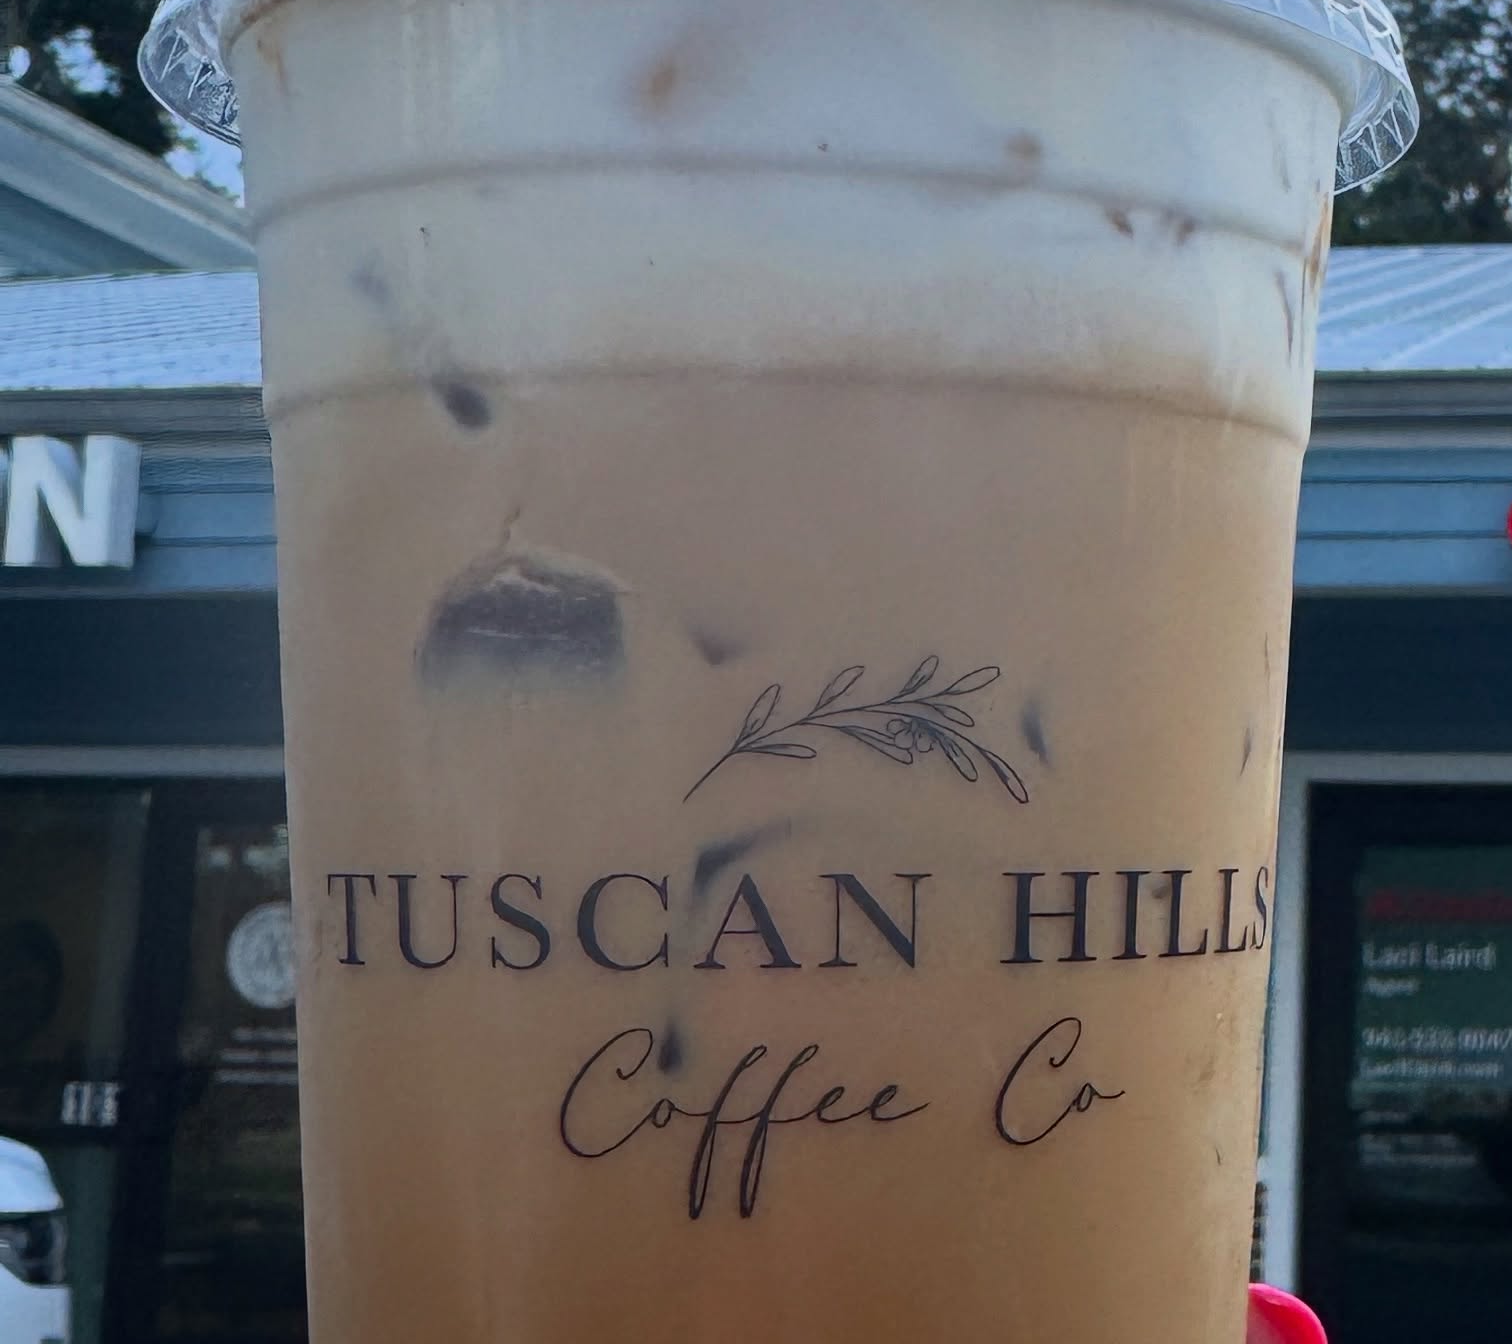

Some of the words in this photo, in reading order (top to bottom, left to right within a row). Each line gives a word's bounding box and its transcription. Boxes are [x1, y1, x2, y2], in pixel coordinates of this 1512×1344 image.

[0, 435, 141, 569] N
[327, 872, 933, 972] TUSCAN
[1000, 865, 1269, 965] HILLS
[560, 1026, 931, 1220] Coffee
[995, 1016, 1126, 1146] Co
